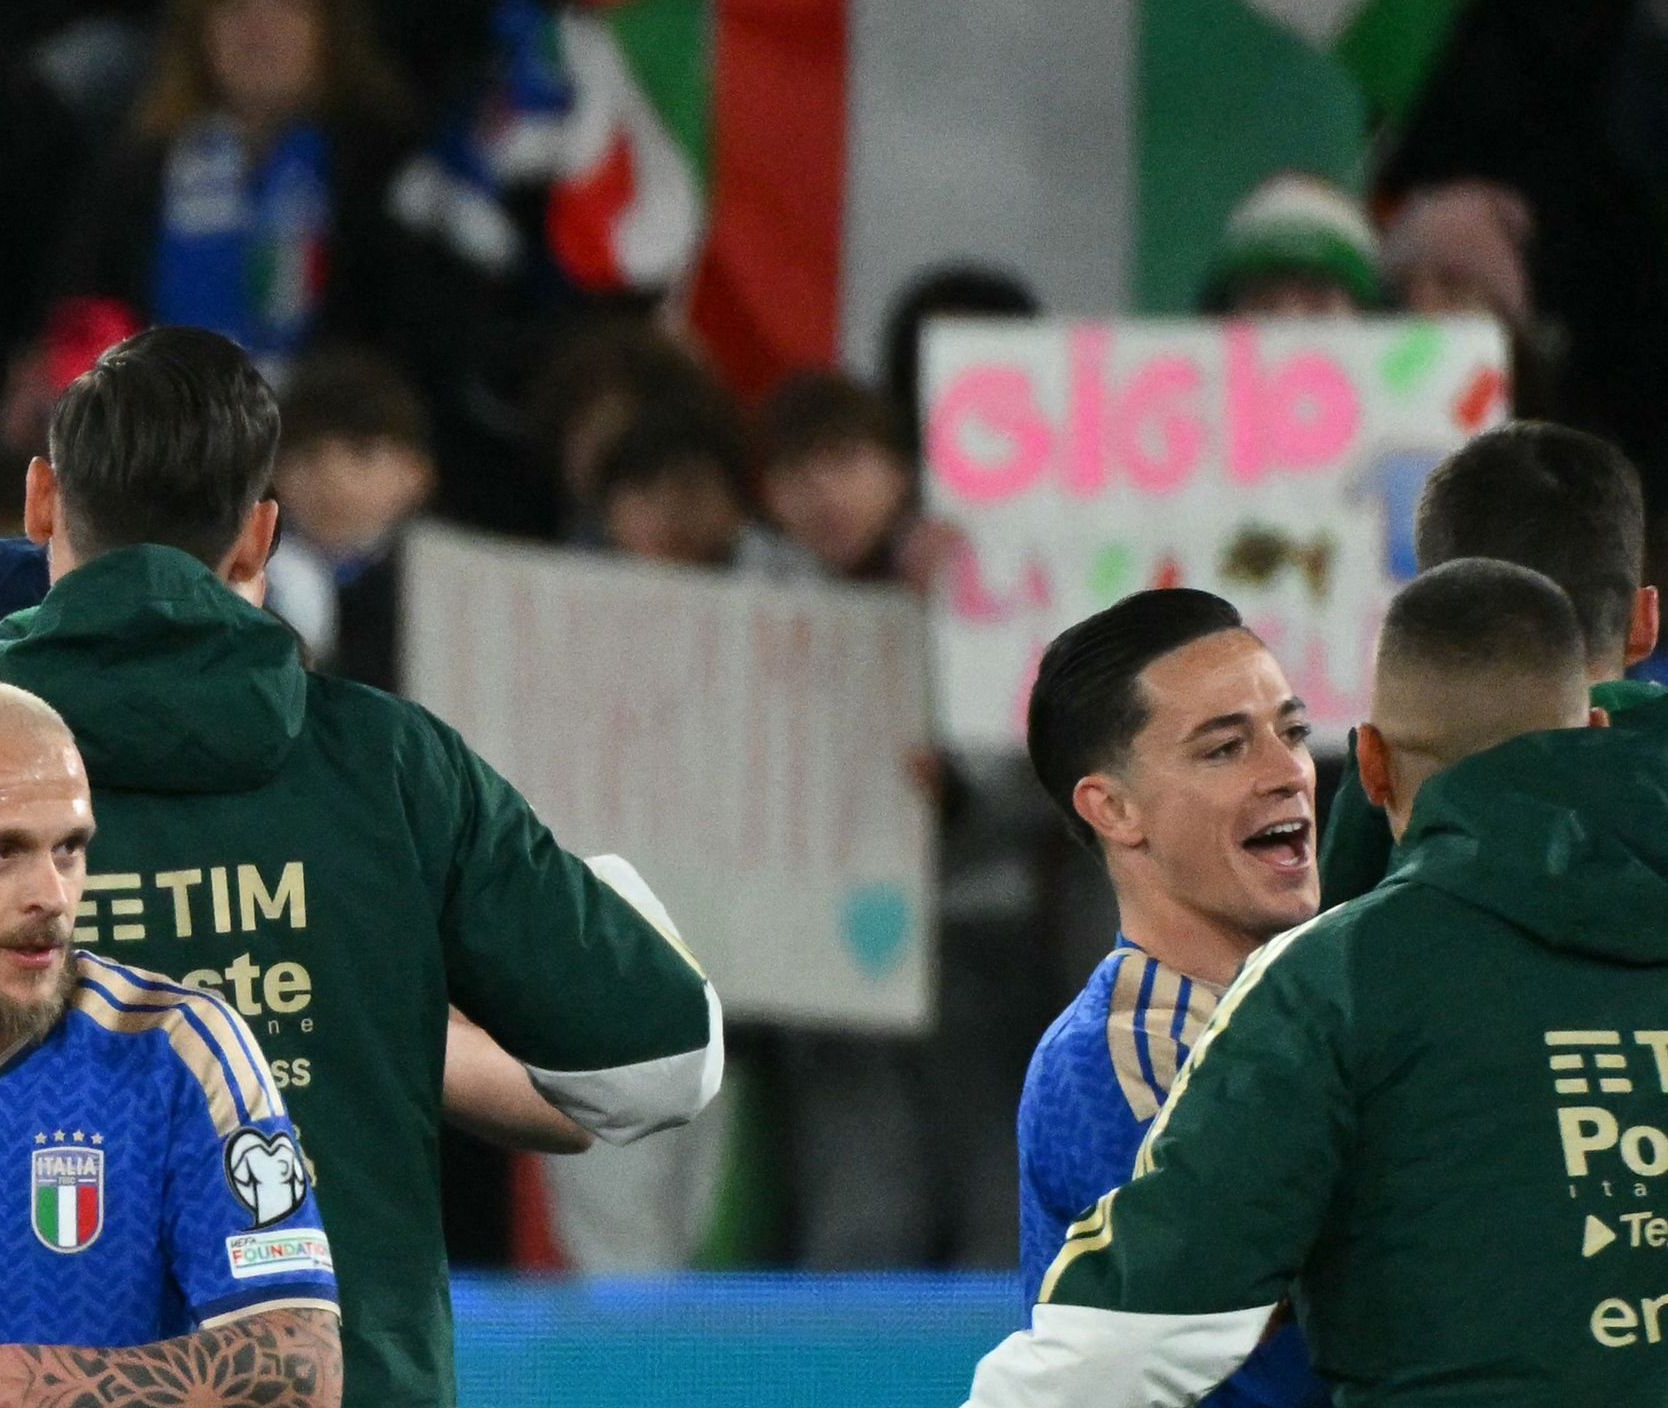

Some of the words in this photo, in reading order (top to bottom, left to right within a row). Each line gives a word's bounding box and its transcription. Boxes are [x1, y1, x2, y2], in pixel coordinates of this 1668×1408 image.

[155, 861, 307, 938] TIM
[182, 952, 313, 1016] ste
[37, 1156, 97, 1175] ITALIA
[232, 1242, 326, 1264] FOUNDATIO
